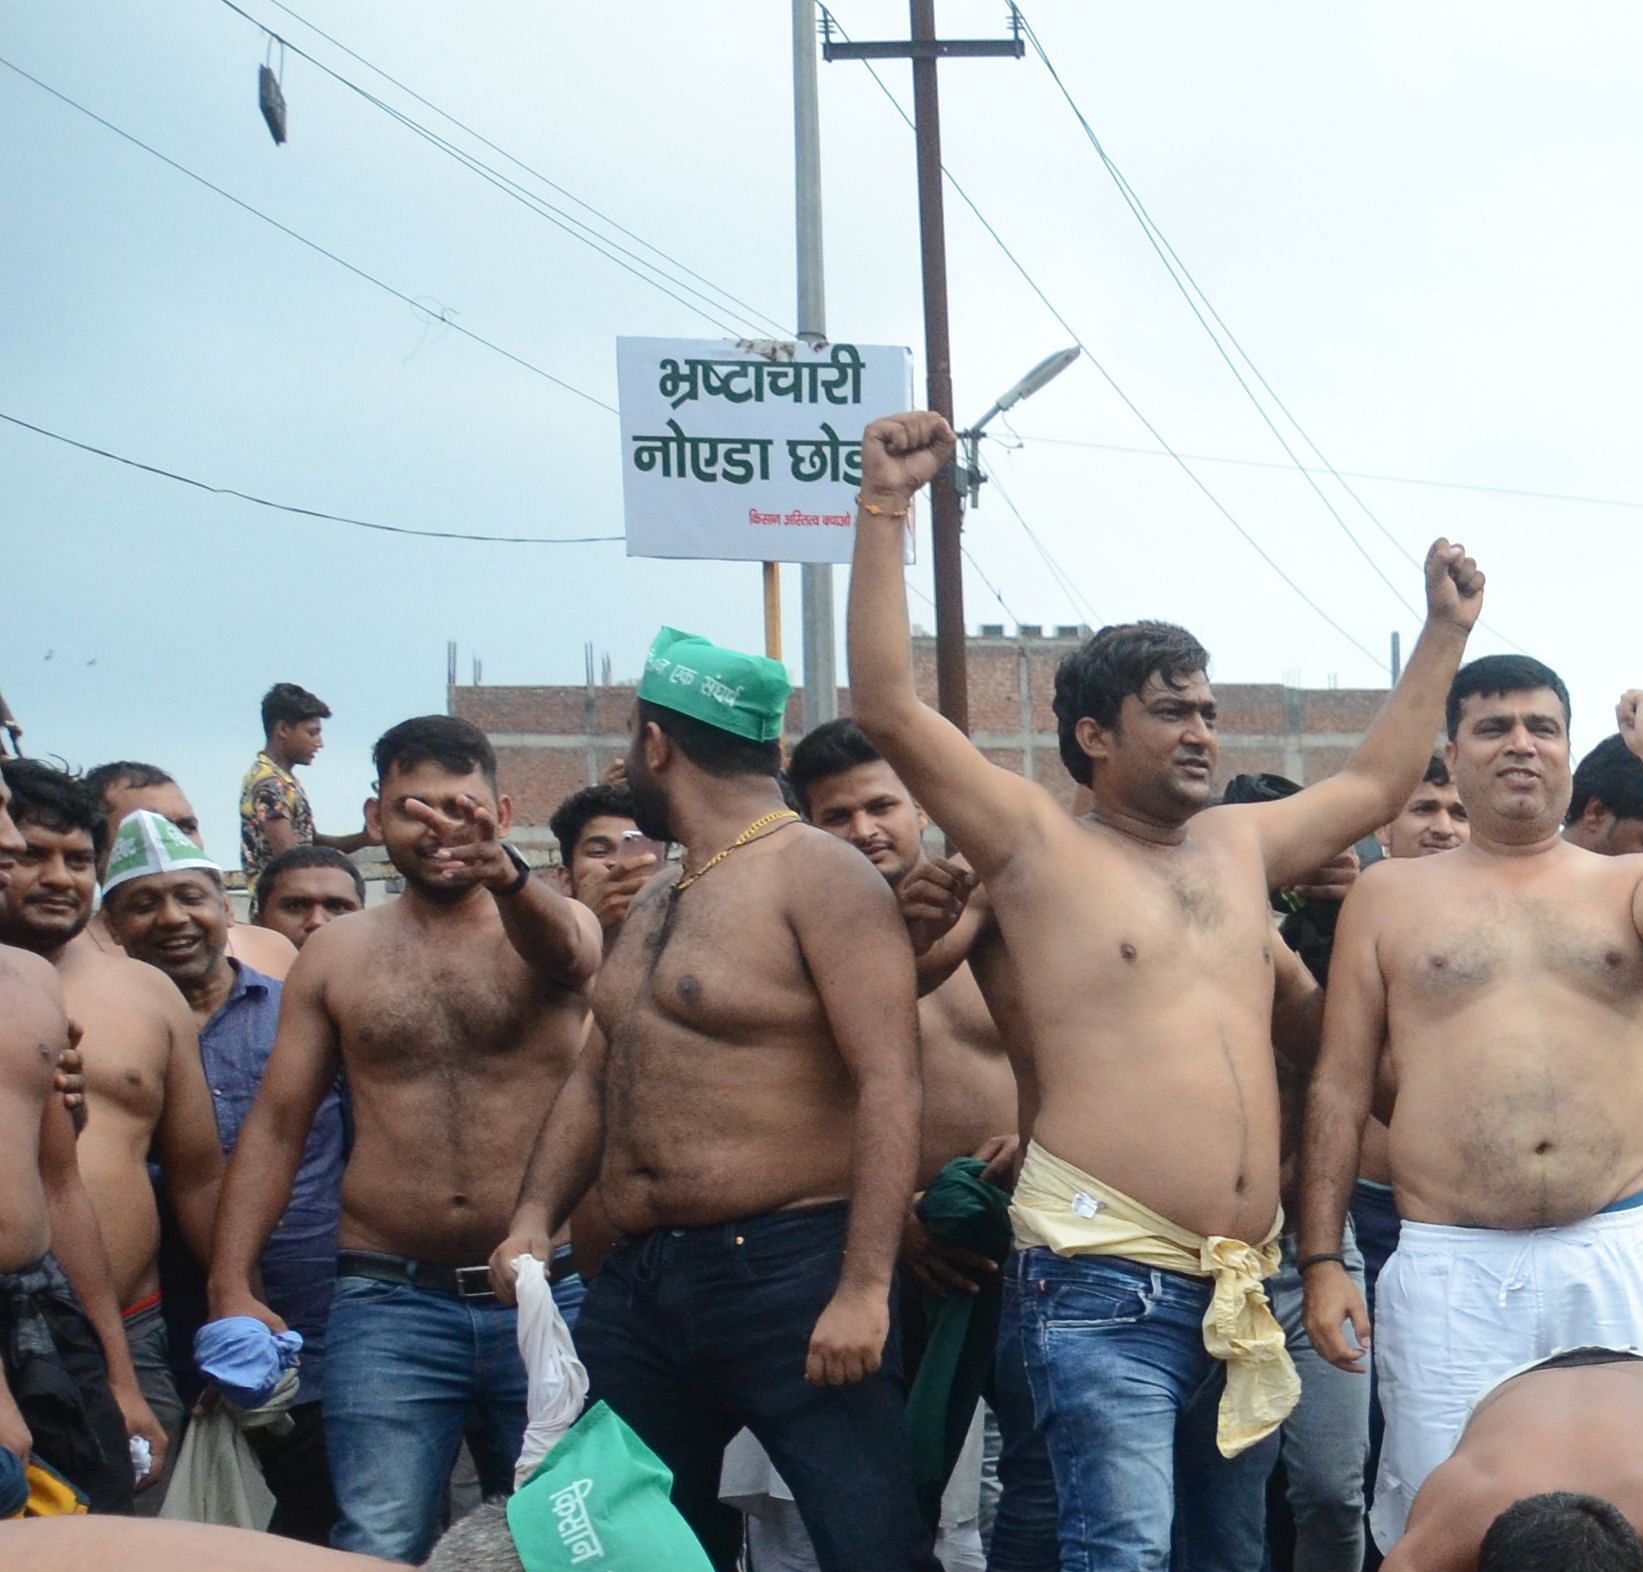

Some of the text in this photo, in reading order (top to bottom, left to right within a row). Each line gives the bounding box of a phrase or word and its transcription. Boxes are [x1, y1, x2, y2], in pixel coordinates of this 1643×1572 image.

[658, 343, 866, 410] भ्रष्टाचारी
[632, 419, 773, 485] नोएडा
[669, 664, 698, 686] एक
[549, 1477, 604, 1565] किसान
